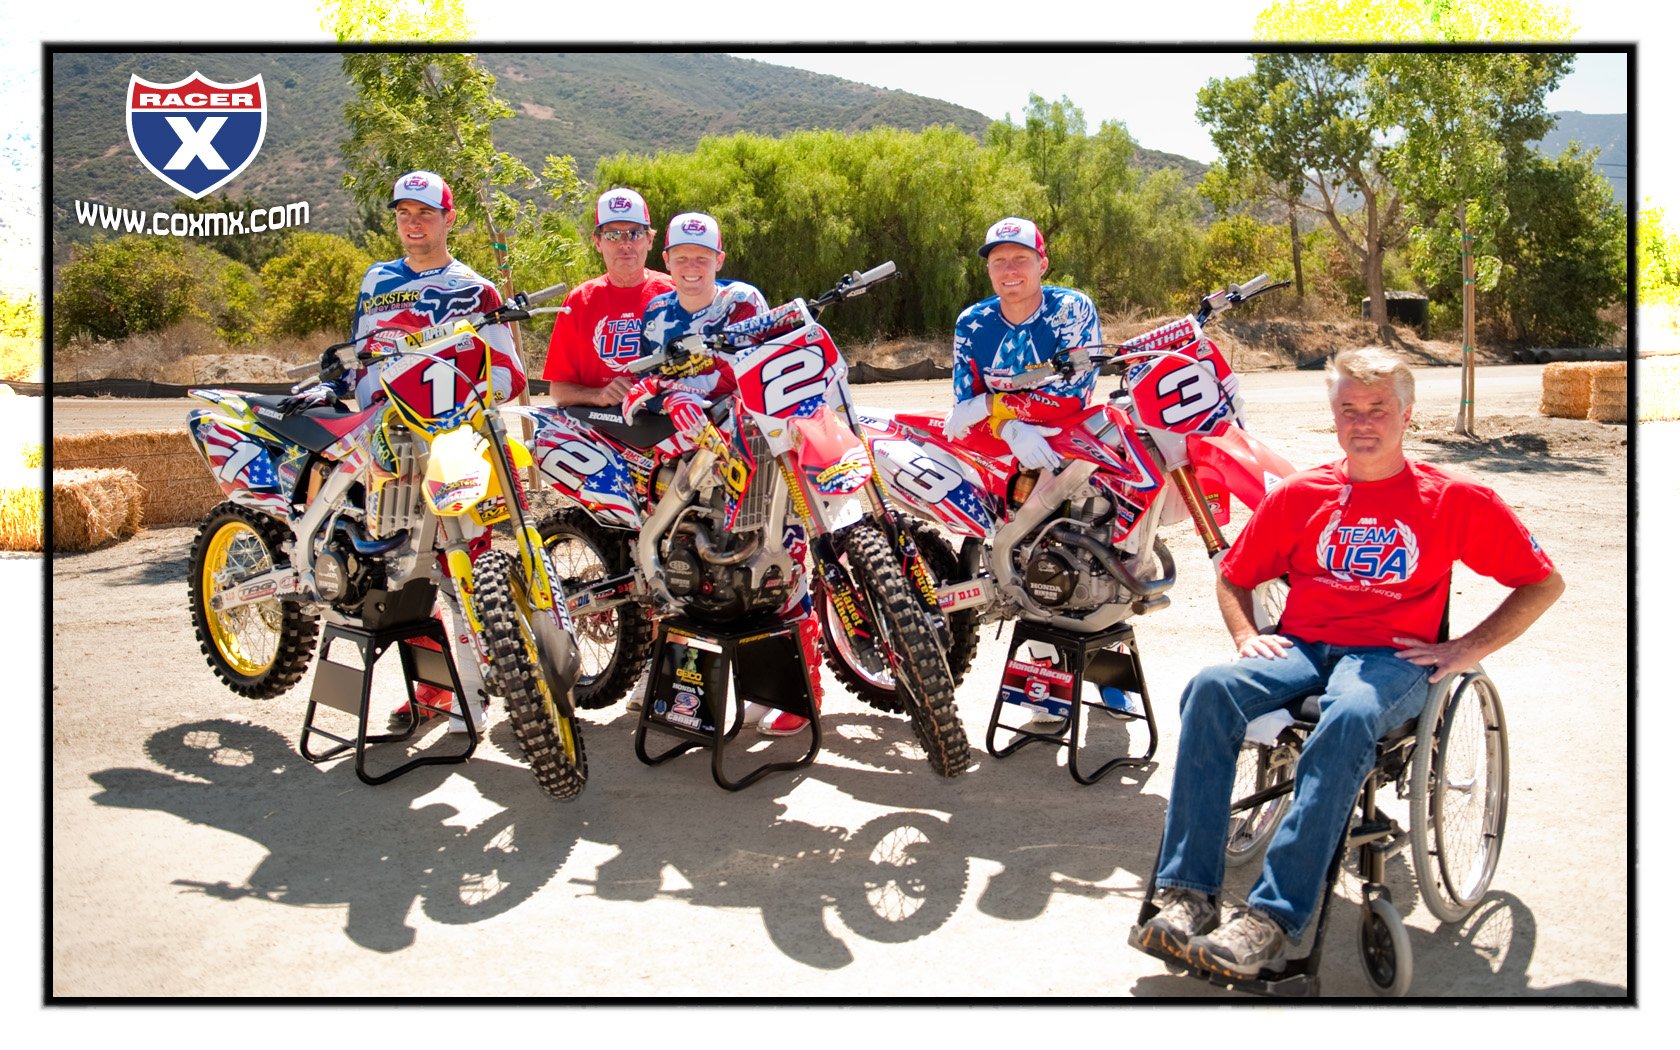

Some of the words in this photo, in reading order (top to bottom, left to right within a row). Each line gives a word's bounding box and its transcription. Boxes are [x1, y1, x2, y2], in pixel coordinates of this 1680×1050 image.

[609, 200, 632, 210] USA
[682, 223, 706, 232] USA
[419, 268, 442, 277] FOX
[599, 331, 641, 359] US
[1024, 361, 1056, 371] DUNLO
[422, 357, 456, 416] 1
[762, 345, 827, 416] 2
[1028, 393, 1060, 408] NDA
[1156, 359, 1220, 426] 3
[588, 411, 624, 425] HONDA
[539, 439, 609, 492] 2
[893, 456, 964, 505] 3
[1337, 526, 1398, 545] TEAM
[1325, 545, 1408, 582] USA
[1030, 582, 1062, 592] HONDA
[1371, 587, 1403, 600] NATIONS
[676, 668, 703, 681] GEICO
[1008, 660, 1040, 676] Honda
[1039, 667, 1073, 684] Racing
[672, 682, 697, 694] HONDA
[1028, 682, 1047, 700] 3
[672, 692, 701, 718] 2
[667, 713, 701, 730] canard
